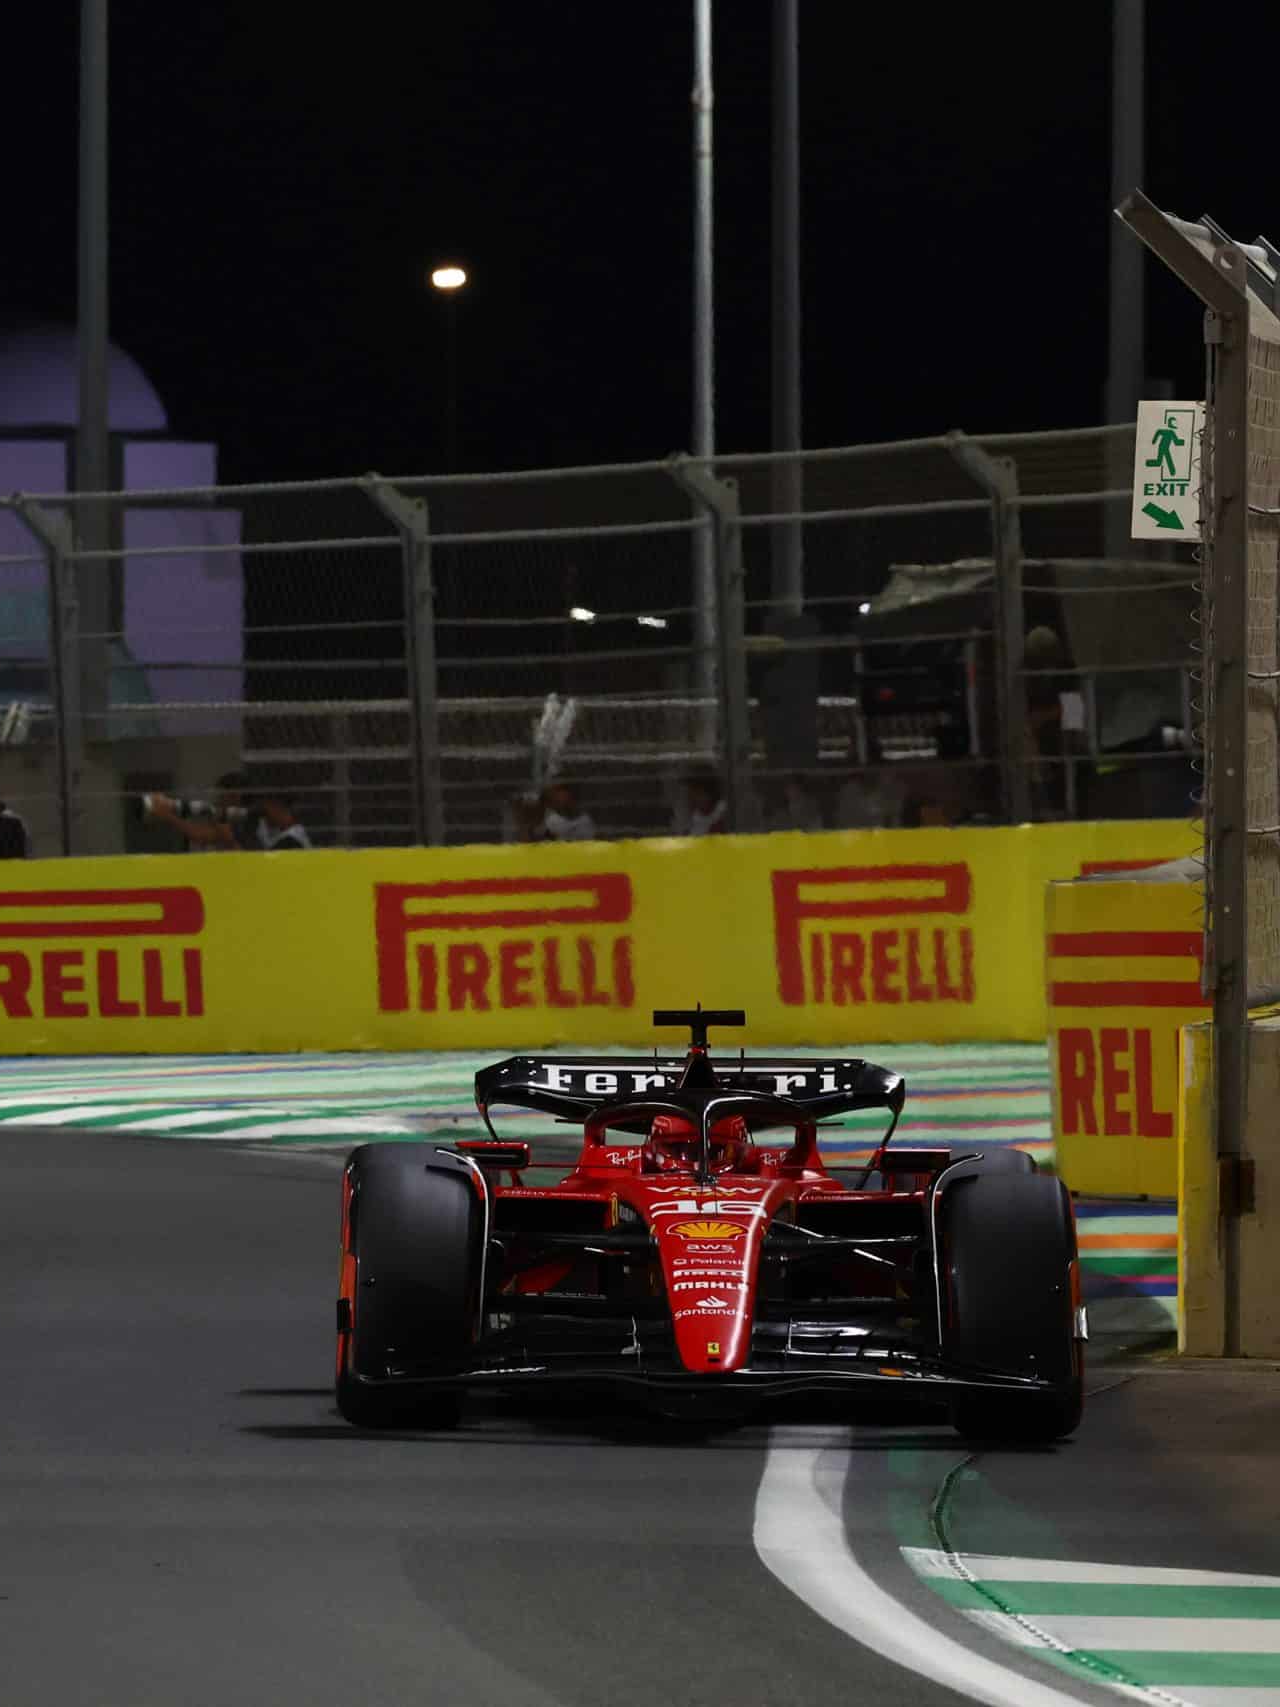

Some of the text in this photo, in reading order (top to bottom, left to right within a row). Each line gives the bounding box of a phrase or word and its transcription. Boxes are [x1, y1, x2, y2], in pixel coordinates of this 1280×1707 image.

[1143, 483, 1189, 496] EXIT
[373, 872, 635, 1014] PIRELLI
[771, 861, 975, 1006] PIRELLI
[541, 1063, 841, 1096] Ferri
[649, 1200, 768, 1219] 16
